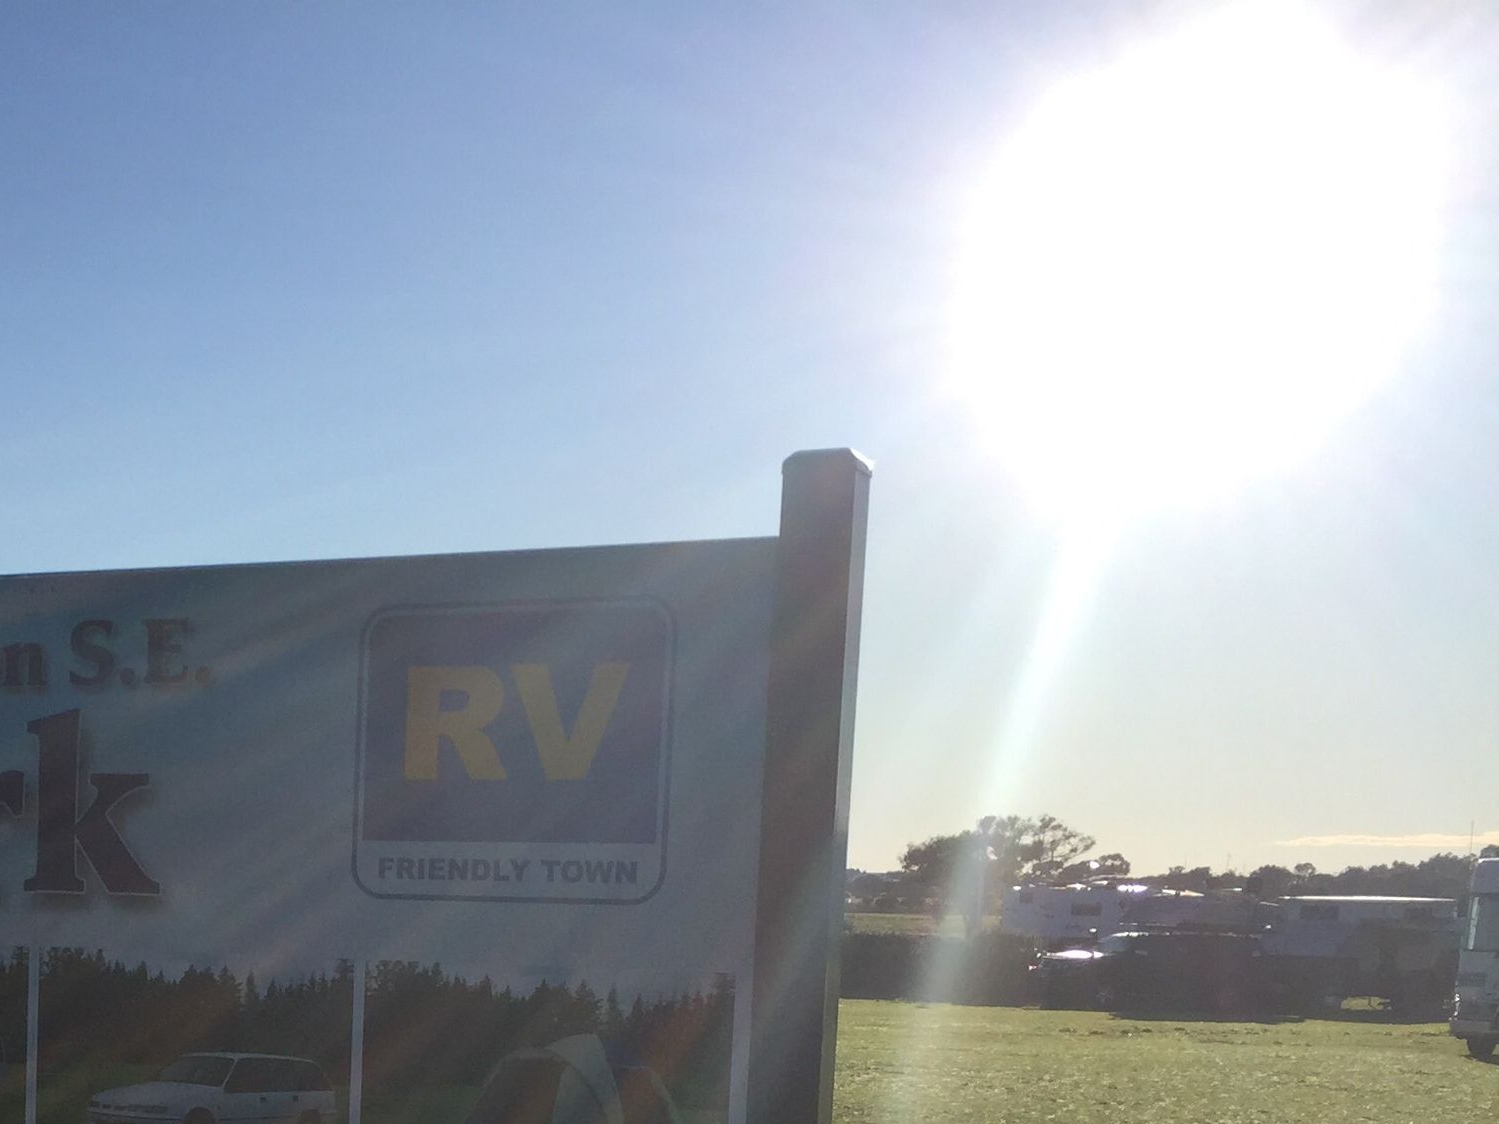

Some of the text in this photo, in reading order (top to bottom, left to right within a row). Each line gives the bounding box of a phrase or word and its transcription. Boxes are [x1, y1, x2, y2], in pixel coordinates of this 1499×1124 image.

[68, 619, 210, 687] S.E.
[403, 661, 631, 781] RV
[378, 857, 638, 884] FRIENDLY TOWN
